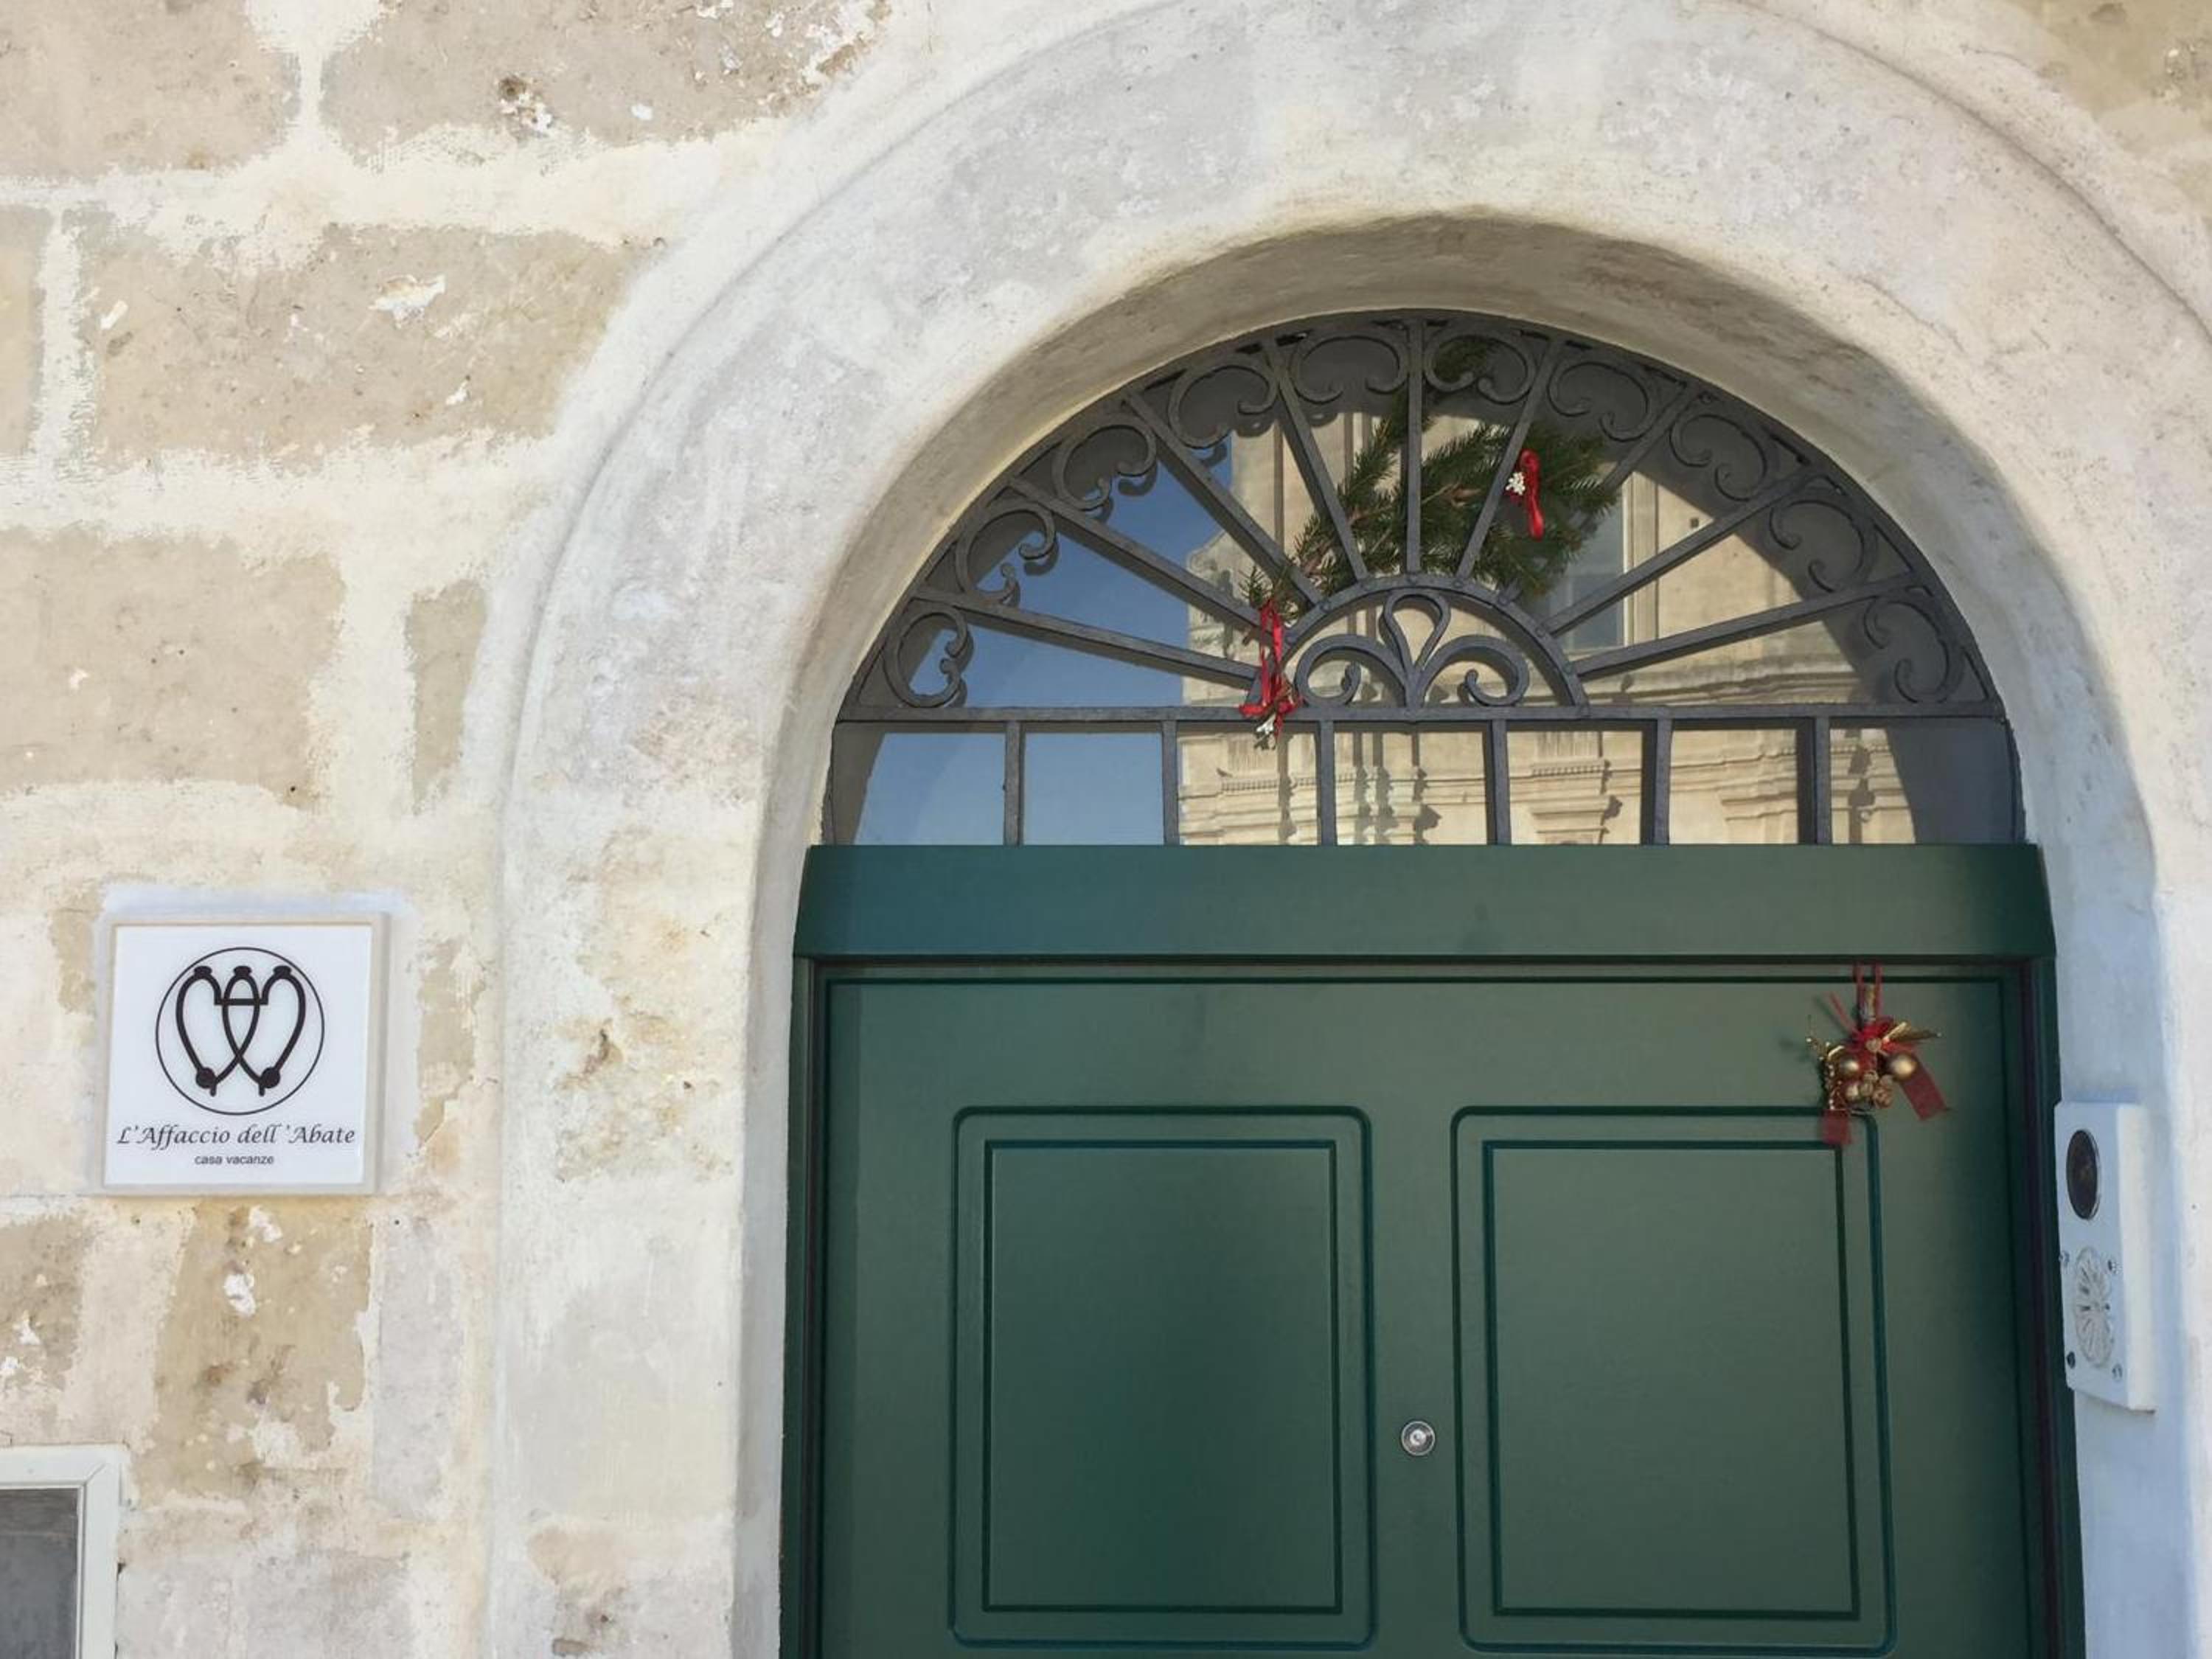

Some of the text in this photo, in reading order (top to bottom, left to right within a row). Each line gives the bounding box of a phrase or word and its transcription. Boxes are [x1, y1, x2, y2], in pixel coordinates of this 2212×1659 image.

[116, 1123, 230, 1151] L'Affaccio
[194, 1155, 275, 1165] casa vacanze
